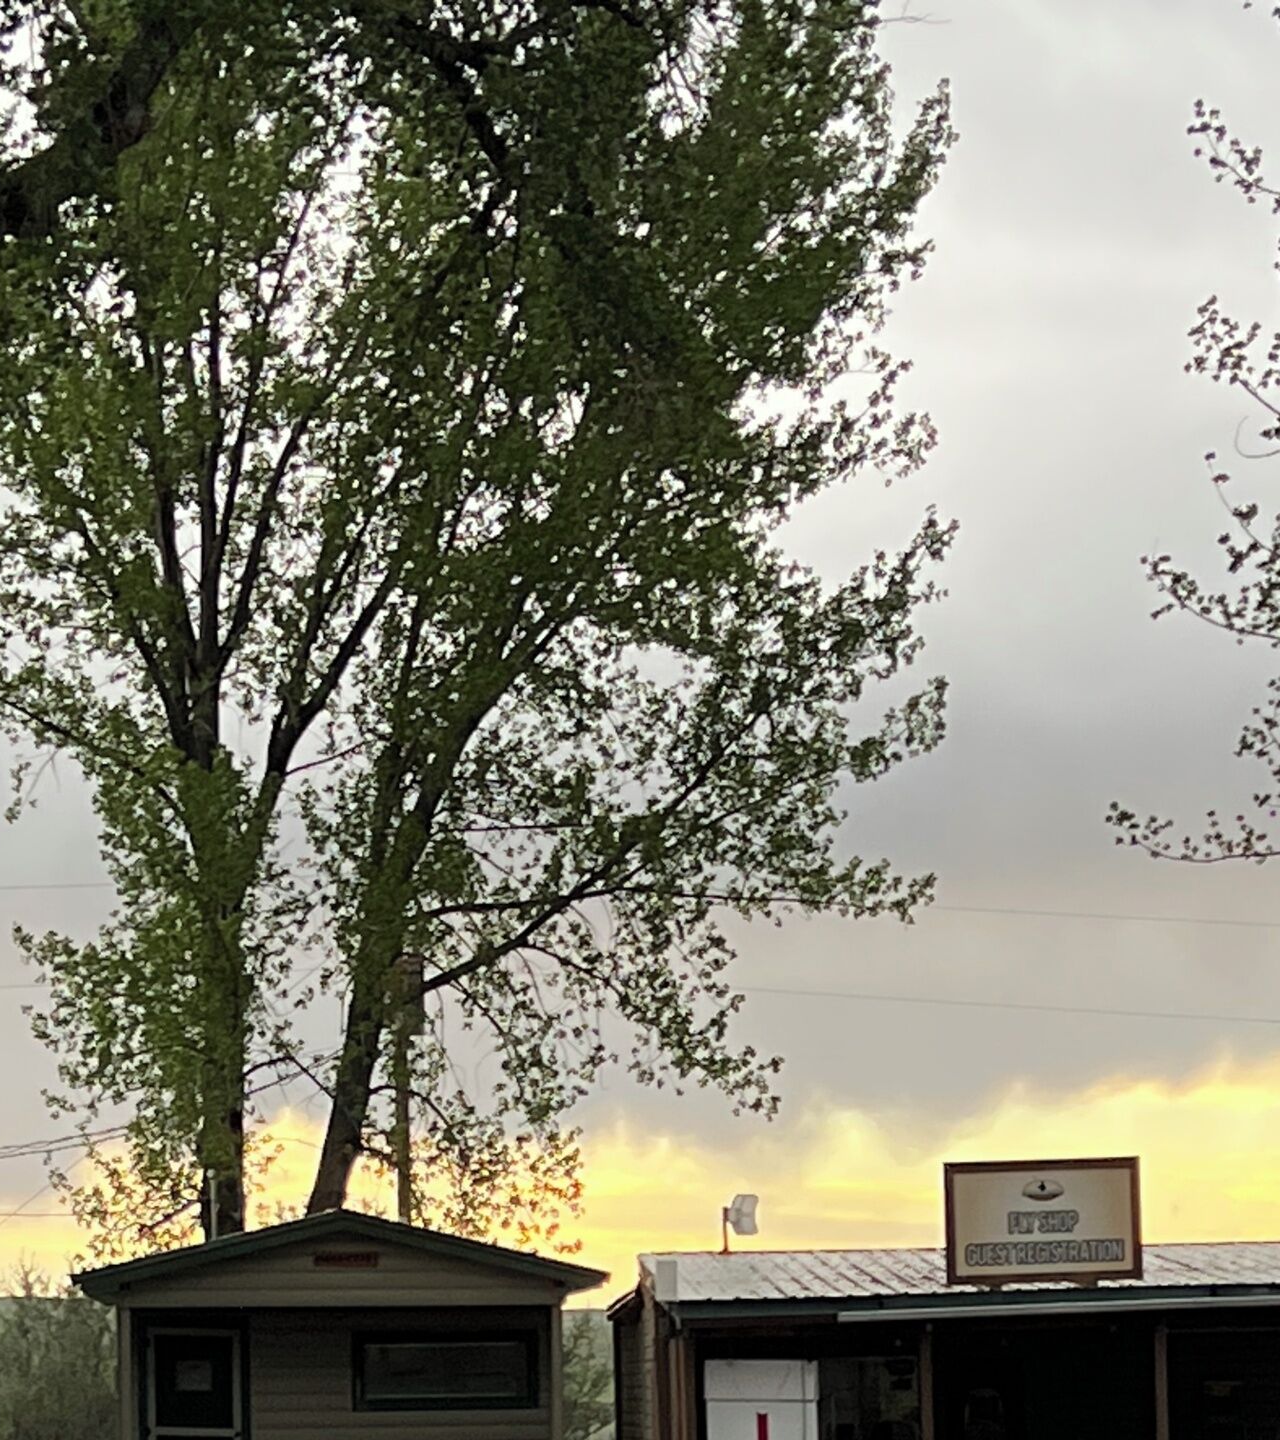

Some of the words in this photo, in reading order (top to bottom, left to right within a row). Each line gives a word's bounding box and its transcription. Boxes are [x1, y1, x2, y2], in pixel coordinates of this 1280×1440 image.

[1008, 1211, 1035, 1234] FLY
[1037, 1210, 1079, 1233] SHOP
[965, 1242, 1014, 1266] GUEST
[1016, 1238, 1124, 1264] REGISTRATION
